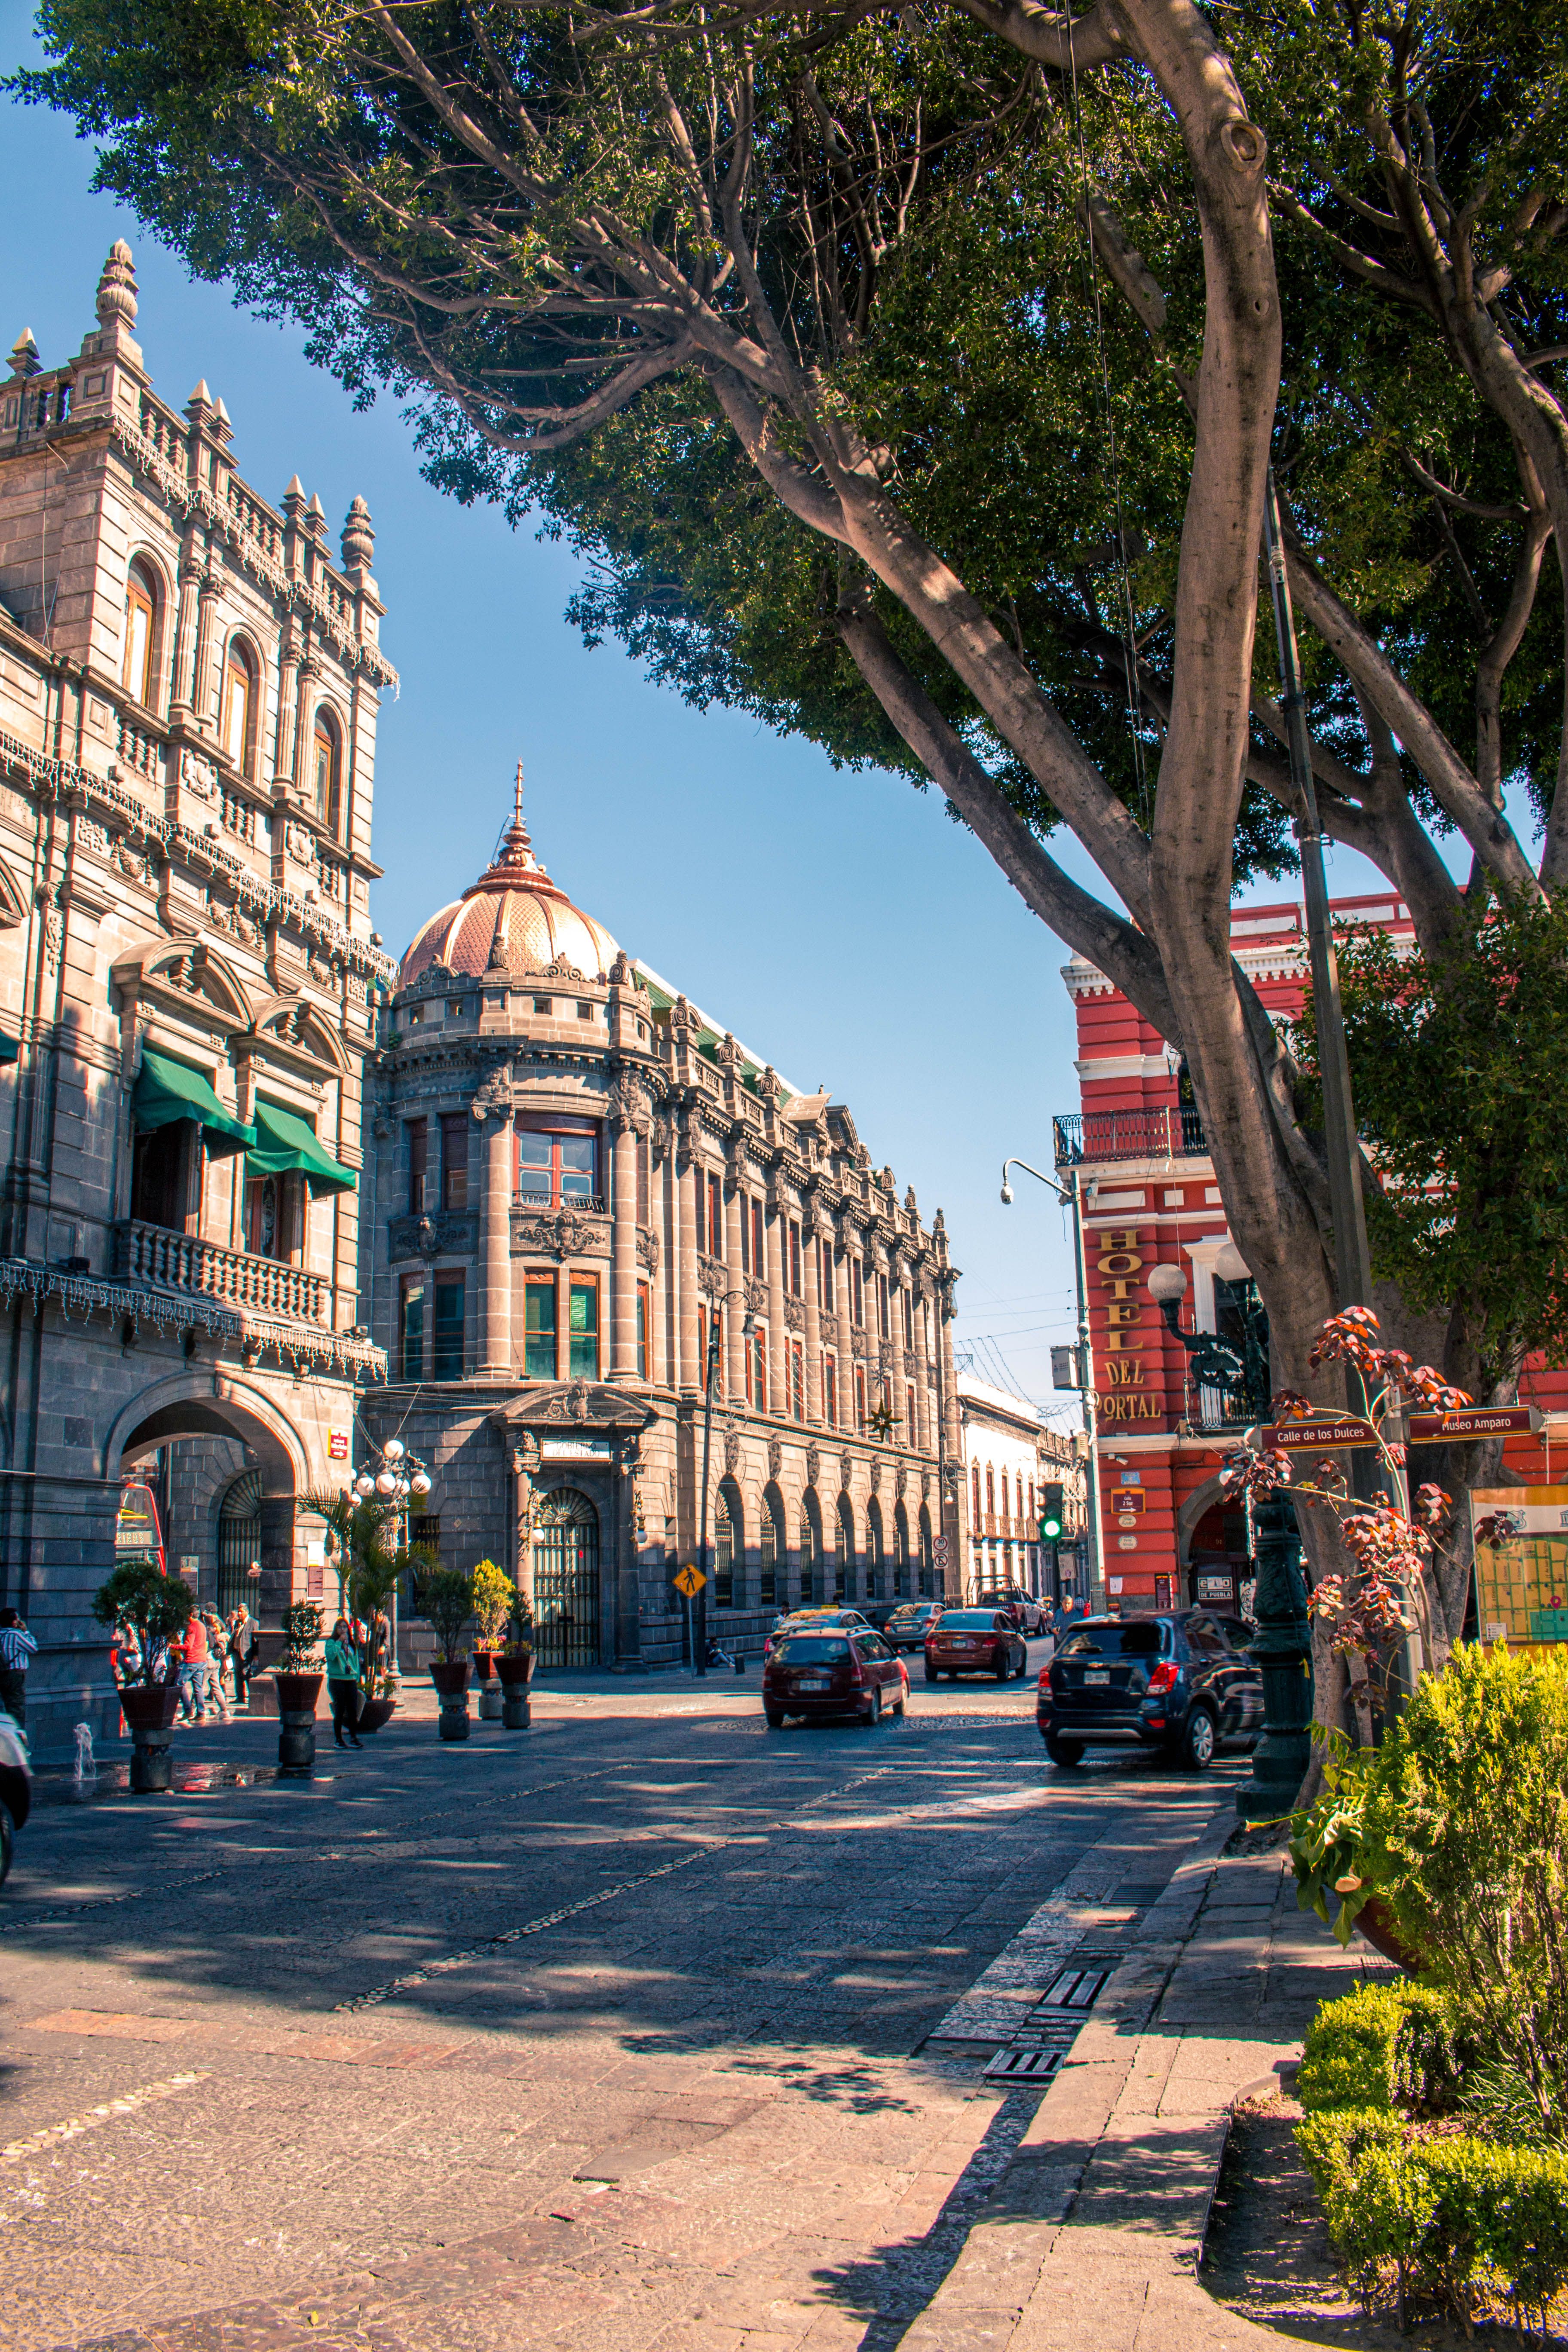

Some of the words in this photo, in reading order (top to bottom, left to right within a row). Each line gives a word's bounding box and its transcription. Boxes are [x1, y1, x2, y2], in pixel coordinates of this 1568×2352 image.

[1096, 1229, 1143, 1351] HOTEL
[1104, 1360, 1144, 1386] DEL
[1442, 1421, 1471, 1430] Museo
[1474, 1418, 1511, 1430] Amparo
[1277, 1431, 1300, 1442] Calle
[1303, 1430, 1315, 1440] de
[1318, 1429, 1332, 1439] los
[1334, 1427, 1364, 1438] Dulces
